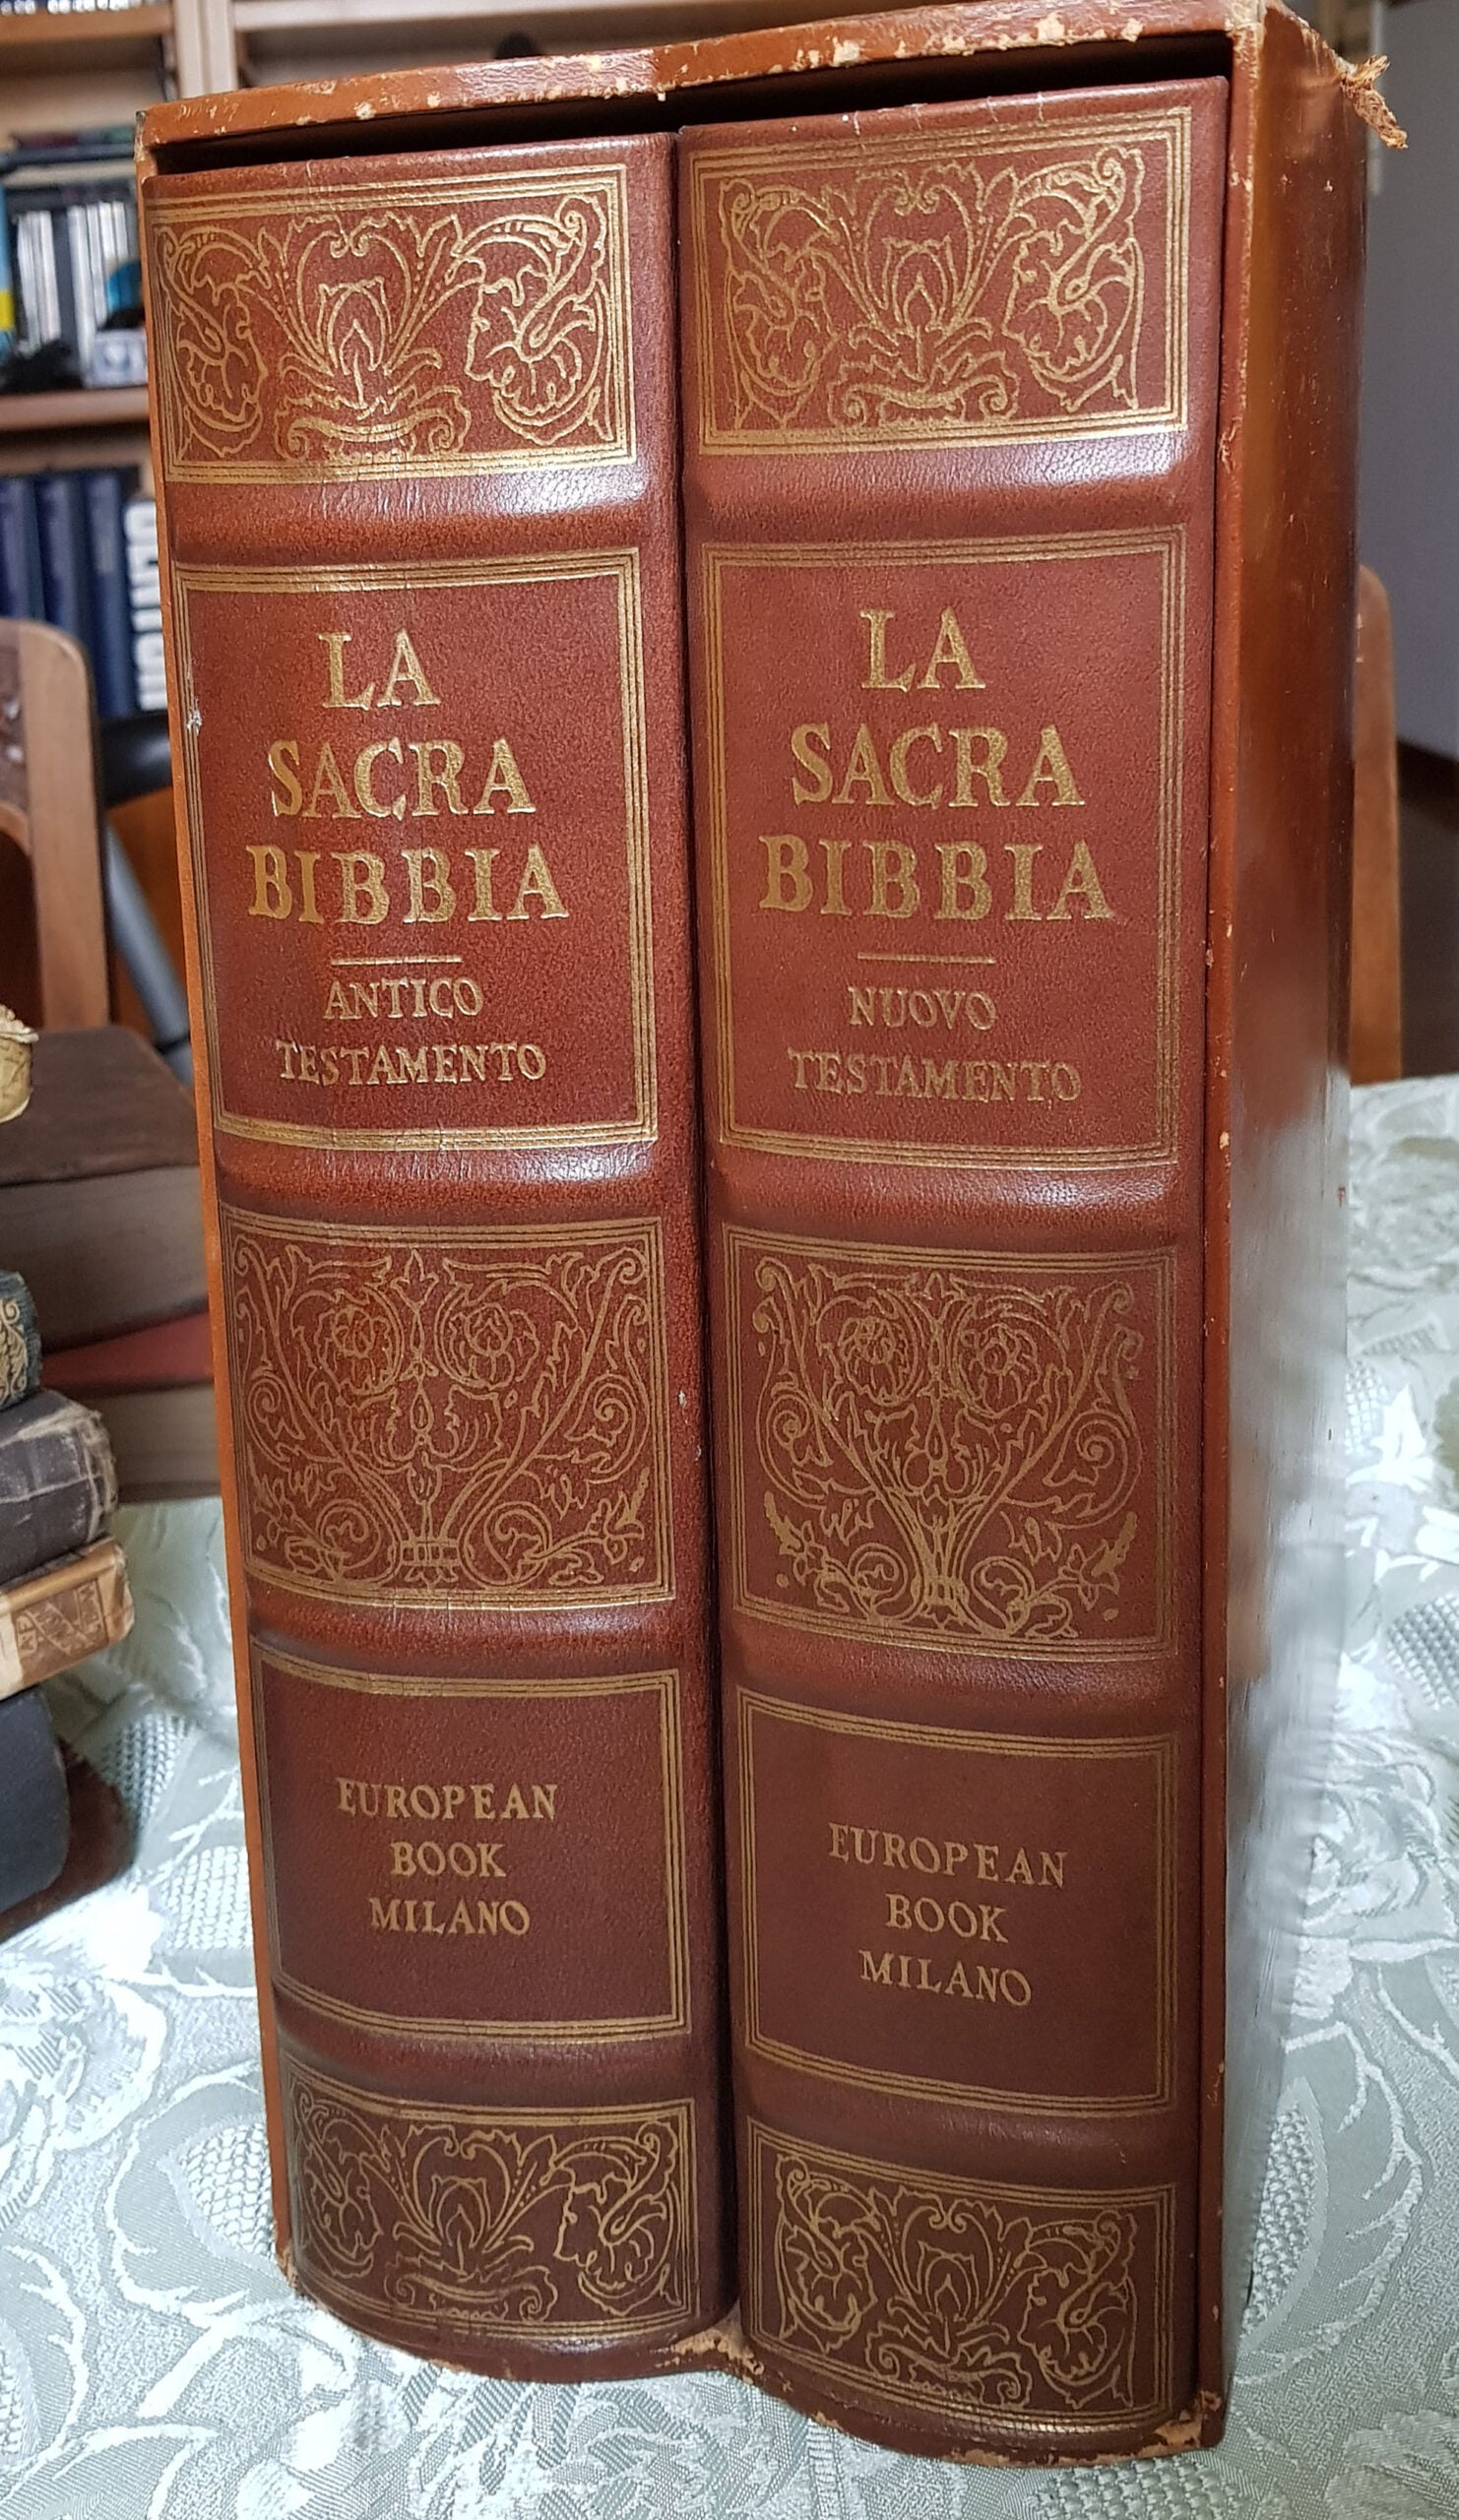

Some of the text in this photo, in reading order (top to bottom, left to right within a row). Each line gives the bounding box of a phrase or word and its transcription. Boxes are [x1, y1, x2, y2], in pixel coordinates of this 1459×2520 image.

[318, 629, 441, 711] LA
[860, 606, 986, 692] LA
[268, 736, 537, 821] SACRA
[791, 723, 1086, 807] SACRA
[246, 844, 570, 925] BIBBIA
[758, 834, 1115, 921] BIBBIA
[323, 977, 484, 1020] ANTICO
[848, 985, 997, 1031] NUOVO
[275, 1039, 547, 1086] TESTAMENTO
[788, 1046, 1082, 1103] TESTAMENTO
[336, 1776, 558, 1821] EUROPEAN
[390, 1840, 507, 1878] BOOK
[828, 1821, 1068, 1889] EUROPEAN
[368, 1896, 532, 1937] MILANO
[885, 1892, 1008, 1944] BOOK
[858, 1949, 1032, 2007] MILANO
